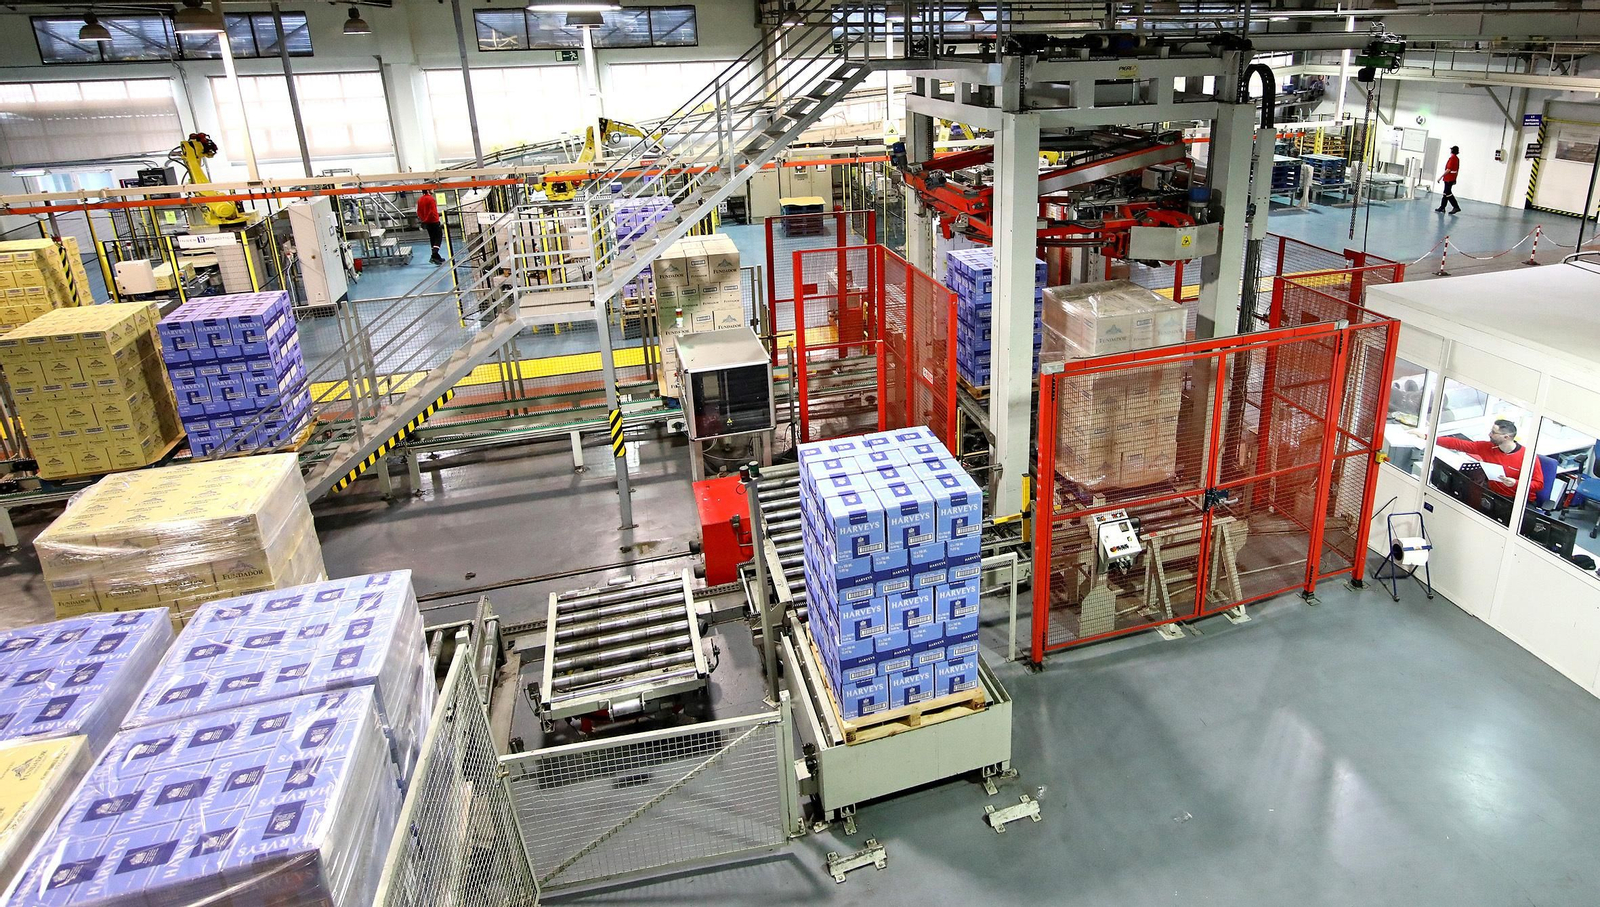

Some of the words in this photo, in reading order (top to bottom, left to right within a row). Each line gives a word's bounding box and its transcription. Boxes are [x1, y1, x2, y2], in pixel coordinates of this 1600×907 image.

[161, 328, 191, 336] HARVEYS
[940, 503, 978, 516] HARVEYS
[891, 512, 930, 525] HARVEYS
[839, 521, 880, 535] HARVEYS
[222, 569, 264, 580] FUNDADOR
[939, 586, 976, 598] HARVEYS
[891, 595, 929, 609] HARVEYS
[842, 606, 882, 619] HARVEYS
[938, 662, 974, 676] HARVEYS
[893, 672, 930, 687] HARVEYS
[846, 683, 884, 697] HARVEYS
[278, 744, 346, 764] HARVEYS
[201, 761, 233, 810] HARVEYS
[128, 774, 167, 825] HARVEYS
[259, 782, 336, 808] HARVEYS
[163, 821, 201, 878] HARVEYS
[86, 836, 131, 896] HARVEYS
